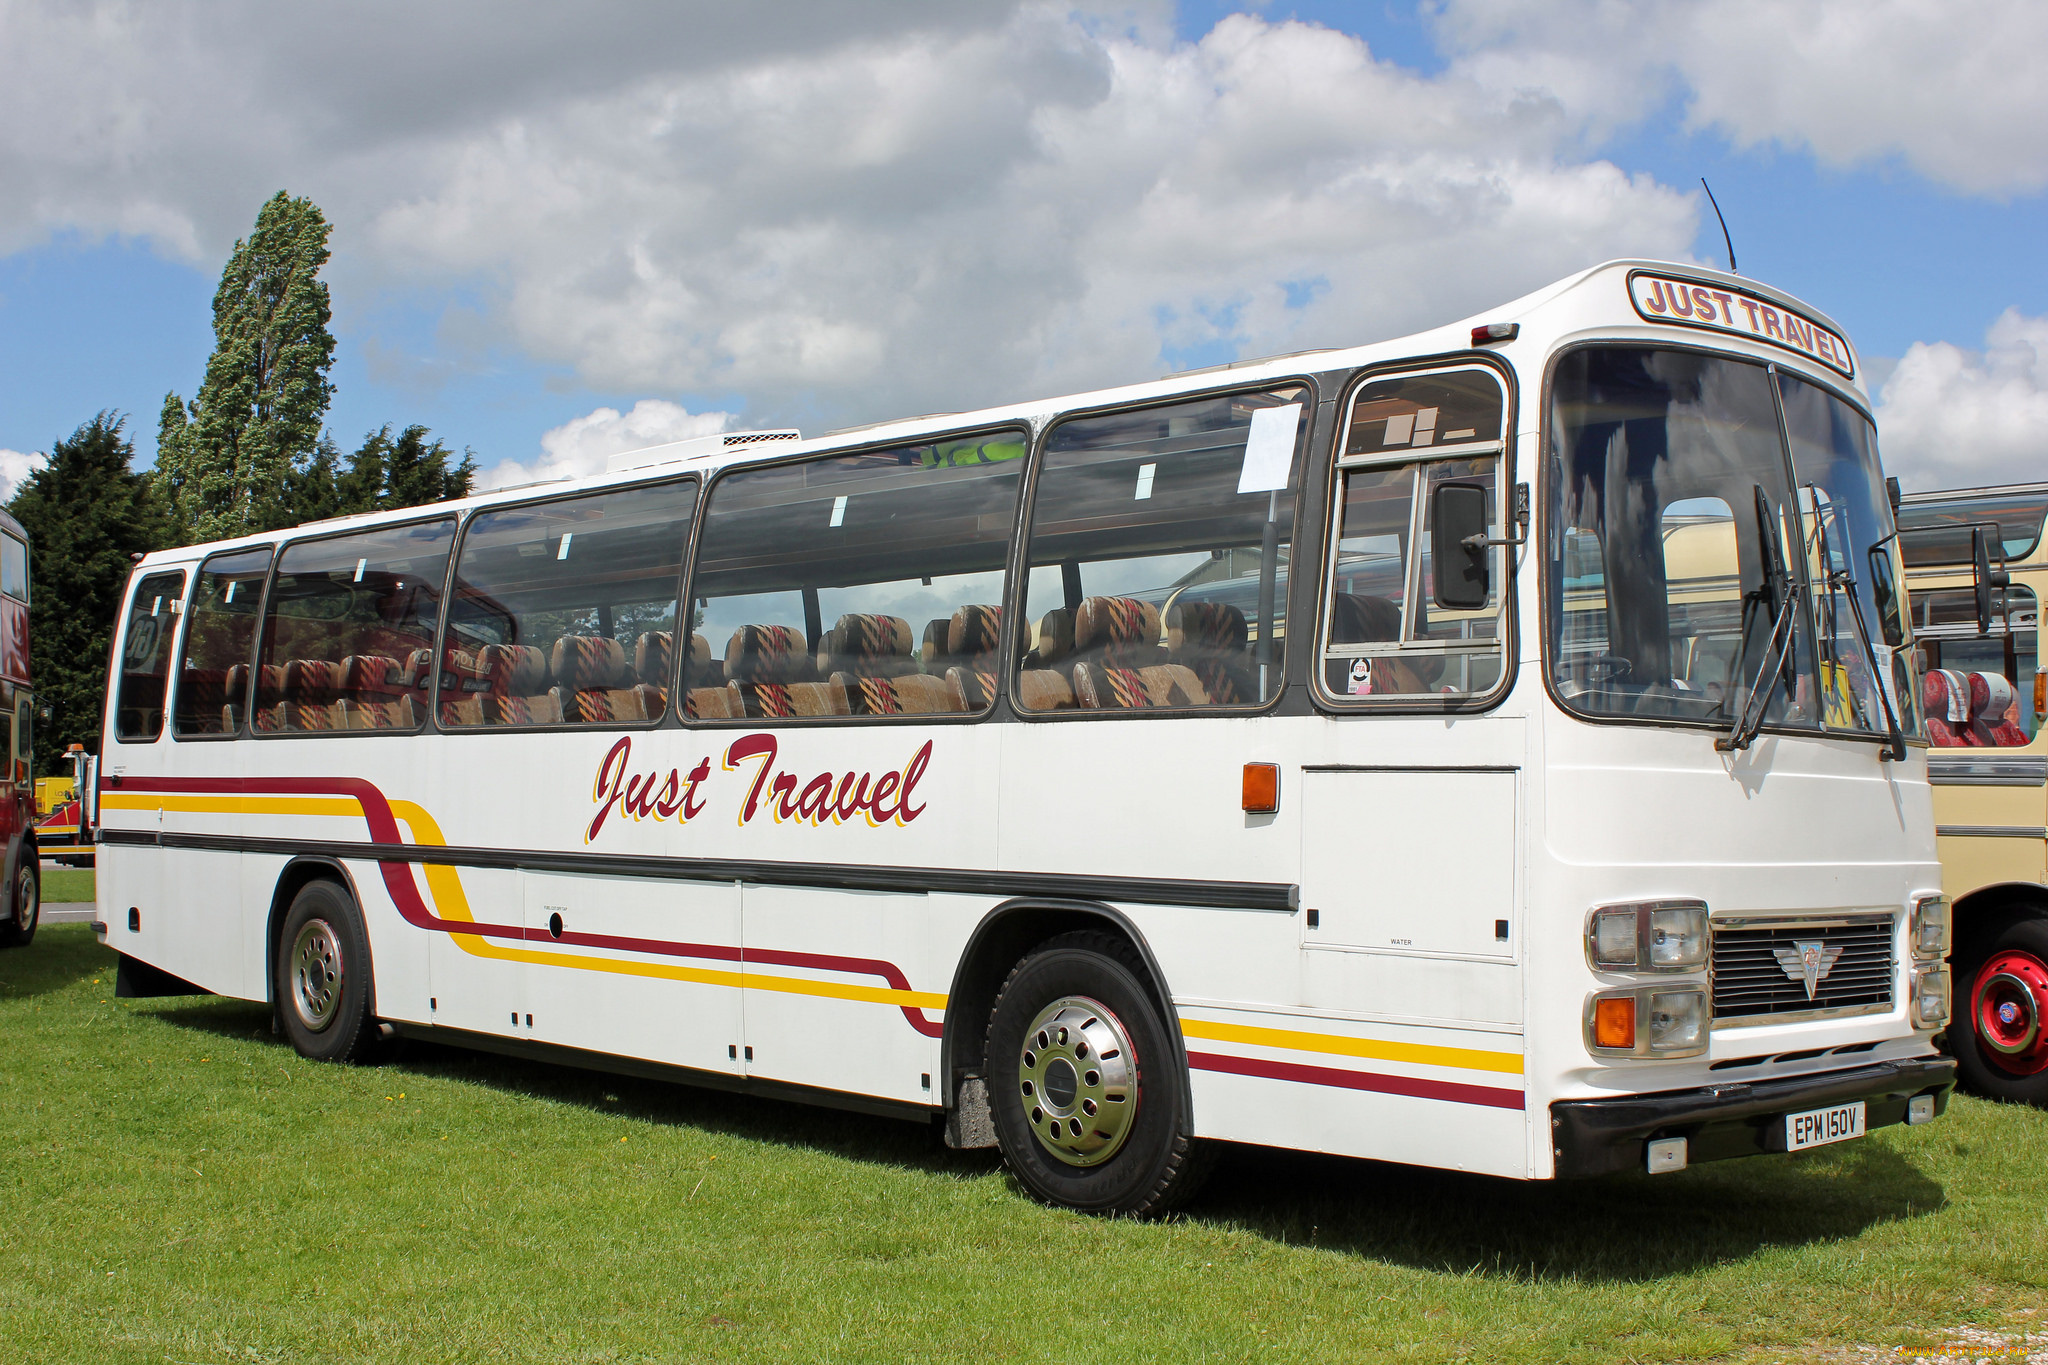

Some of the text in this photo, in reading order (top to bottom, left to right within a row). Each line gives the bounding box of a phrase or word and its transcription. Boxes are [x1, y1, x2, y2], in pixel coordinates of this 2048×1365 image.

[1644, 281, 1848, 369] JUST TRAVEL
[1355, 665, 1366, 673] FTA
[584, 733, 933, 845] Just Travel
[1390, 938, 1412, 946] WATER
[1794, 1107, 1857, 1145] EPM 150V
